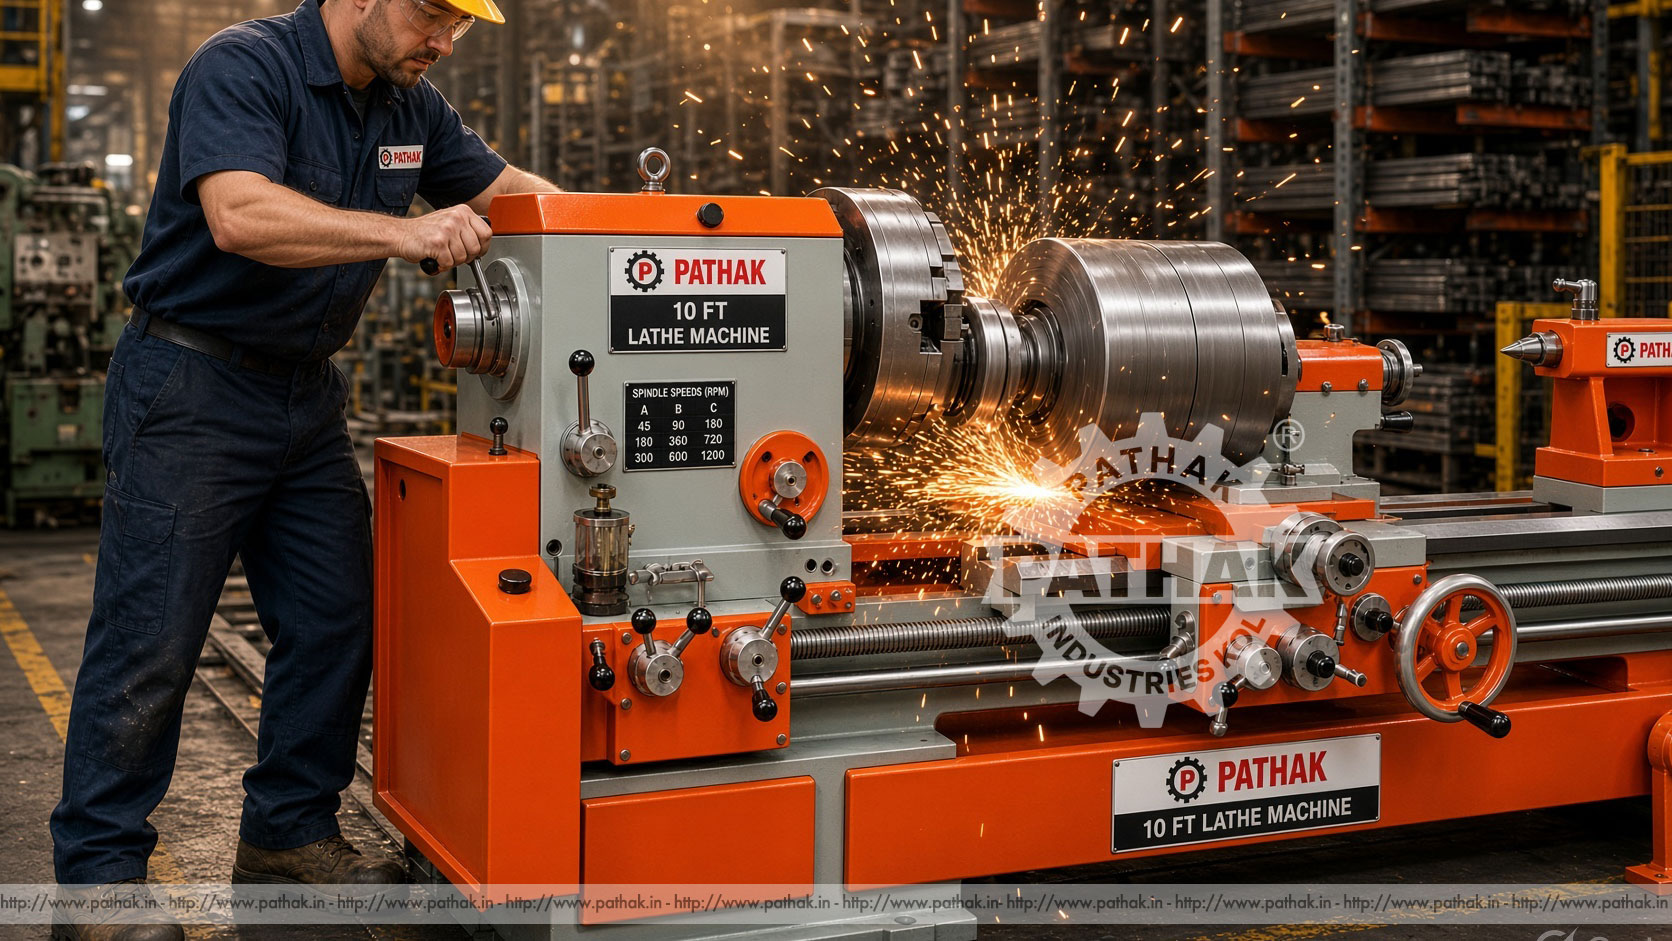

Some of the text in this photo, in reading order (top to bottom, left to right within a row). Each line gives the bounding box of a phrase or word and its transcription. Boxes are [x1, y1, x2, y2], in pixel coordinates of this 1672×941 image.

[394, 151, 421, 164] PATHAK
[638, 259, 766, 285] P PATHAK
[673, 301, 728, 320] 10 FT
[628, 327, 770, 345] LATHE MACHINE
[1640, 342, 1672, 358] PATH
[632, 385, 729, 399] SPINDLE SPEEDS (RPM)
[640, 402, 718, 416] A B C
[637, 418, 723, 431] 45 90 180
[635, 433, 723, 448] 180 360 720
[634, 449, 725, 463] 300 600 1200
[1180, 750, 1328, 793] P PATHAK
[1143, 797, 1352, 839] 10 FT LATHE MACHINE
